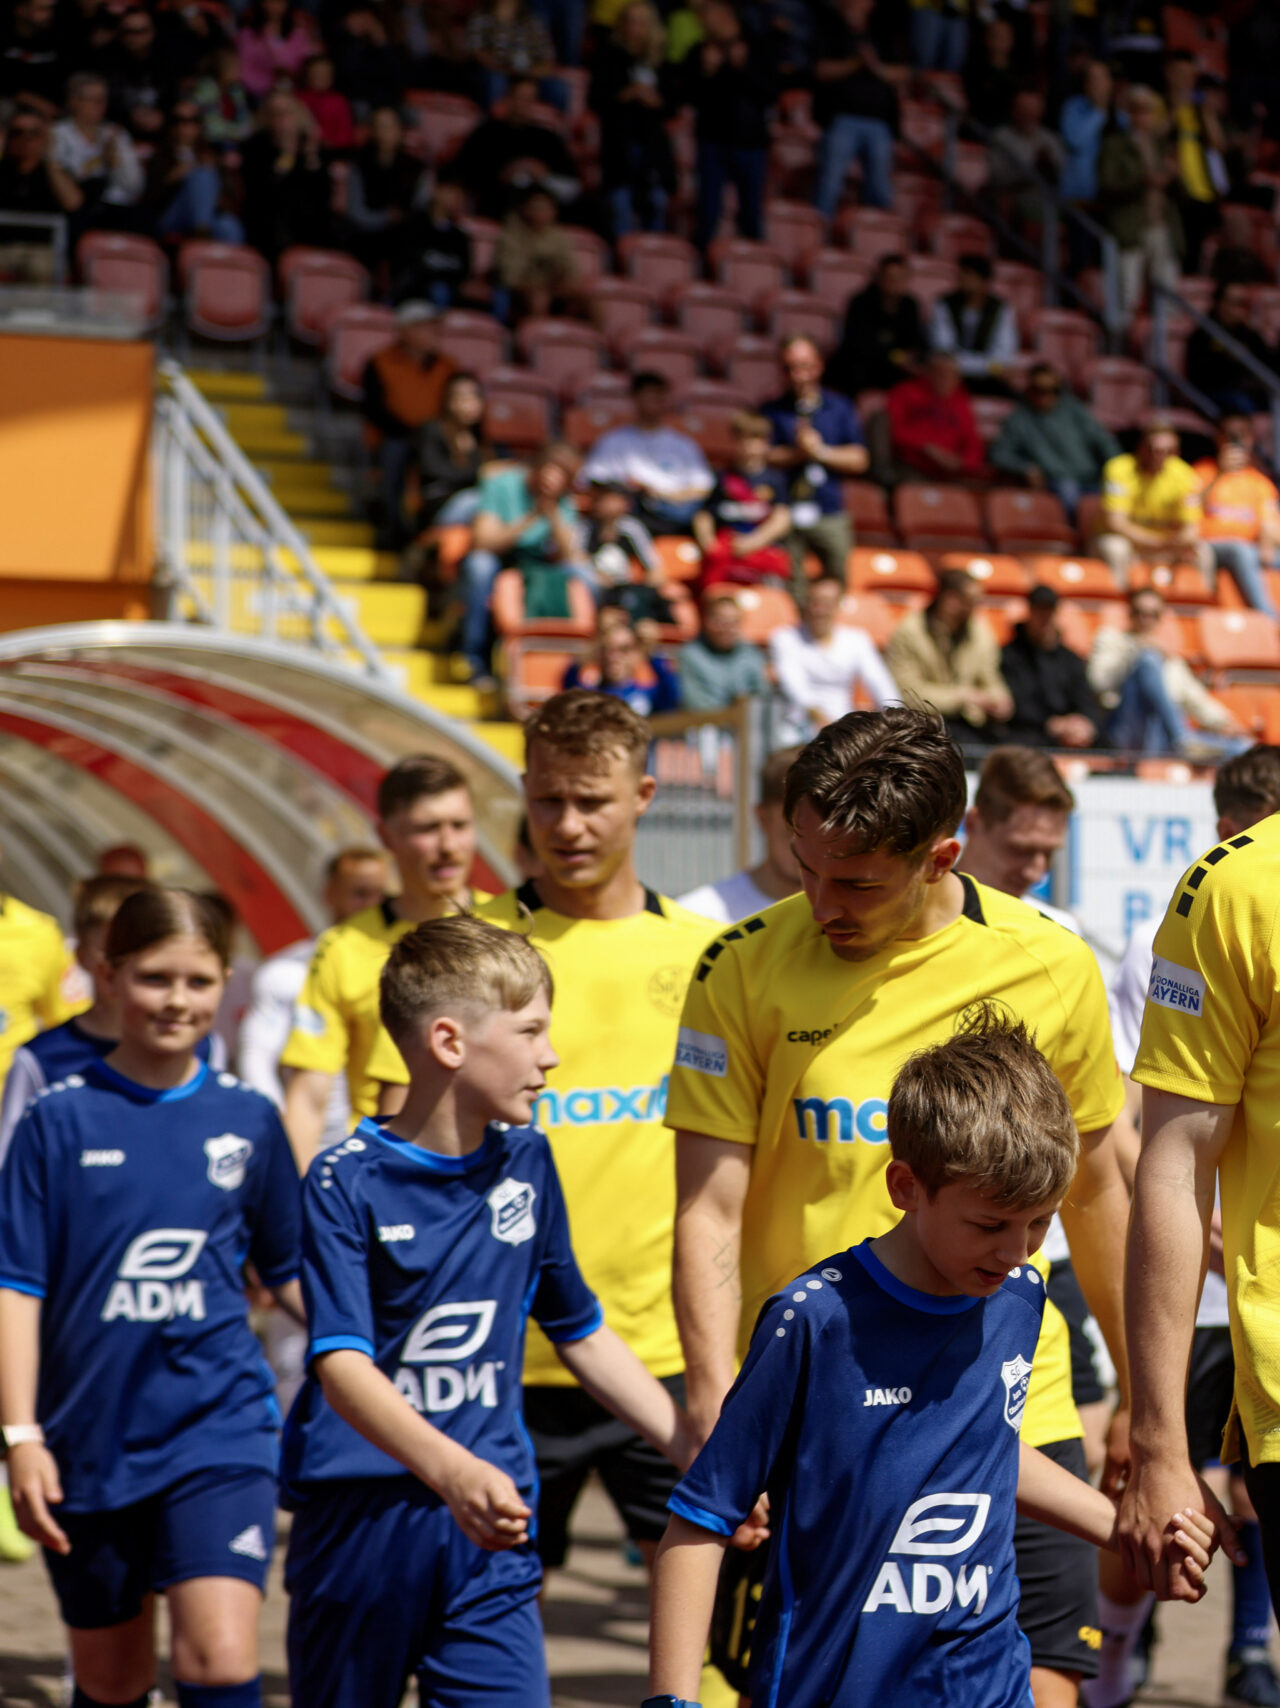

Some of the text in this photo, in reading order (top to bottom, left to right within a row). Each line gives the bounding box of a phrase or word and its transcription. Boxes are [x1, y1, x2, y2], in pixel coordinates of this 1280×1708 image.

[1118, 815, 1194, 863] VR
[1151, 983, 1201, 1012] AYERN
[102, 1280, 206, 1322] ADM
[863, 1387, 912, 1407] JAKO
[862, 1561, 989, 1616] ADM
